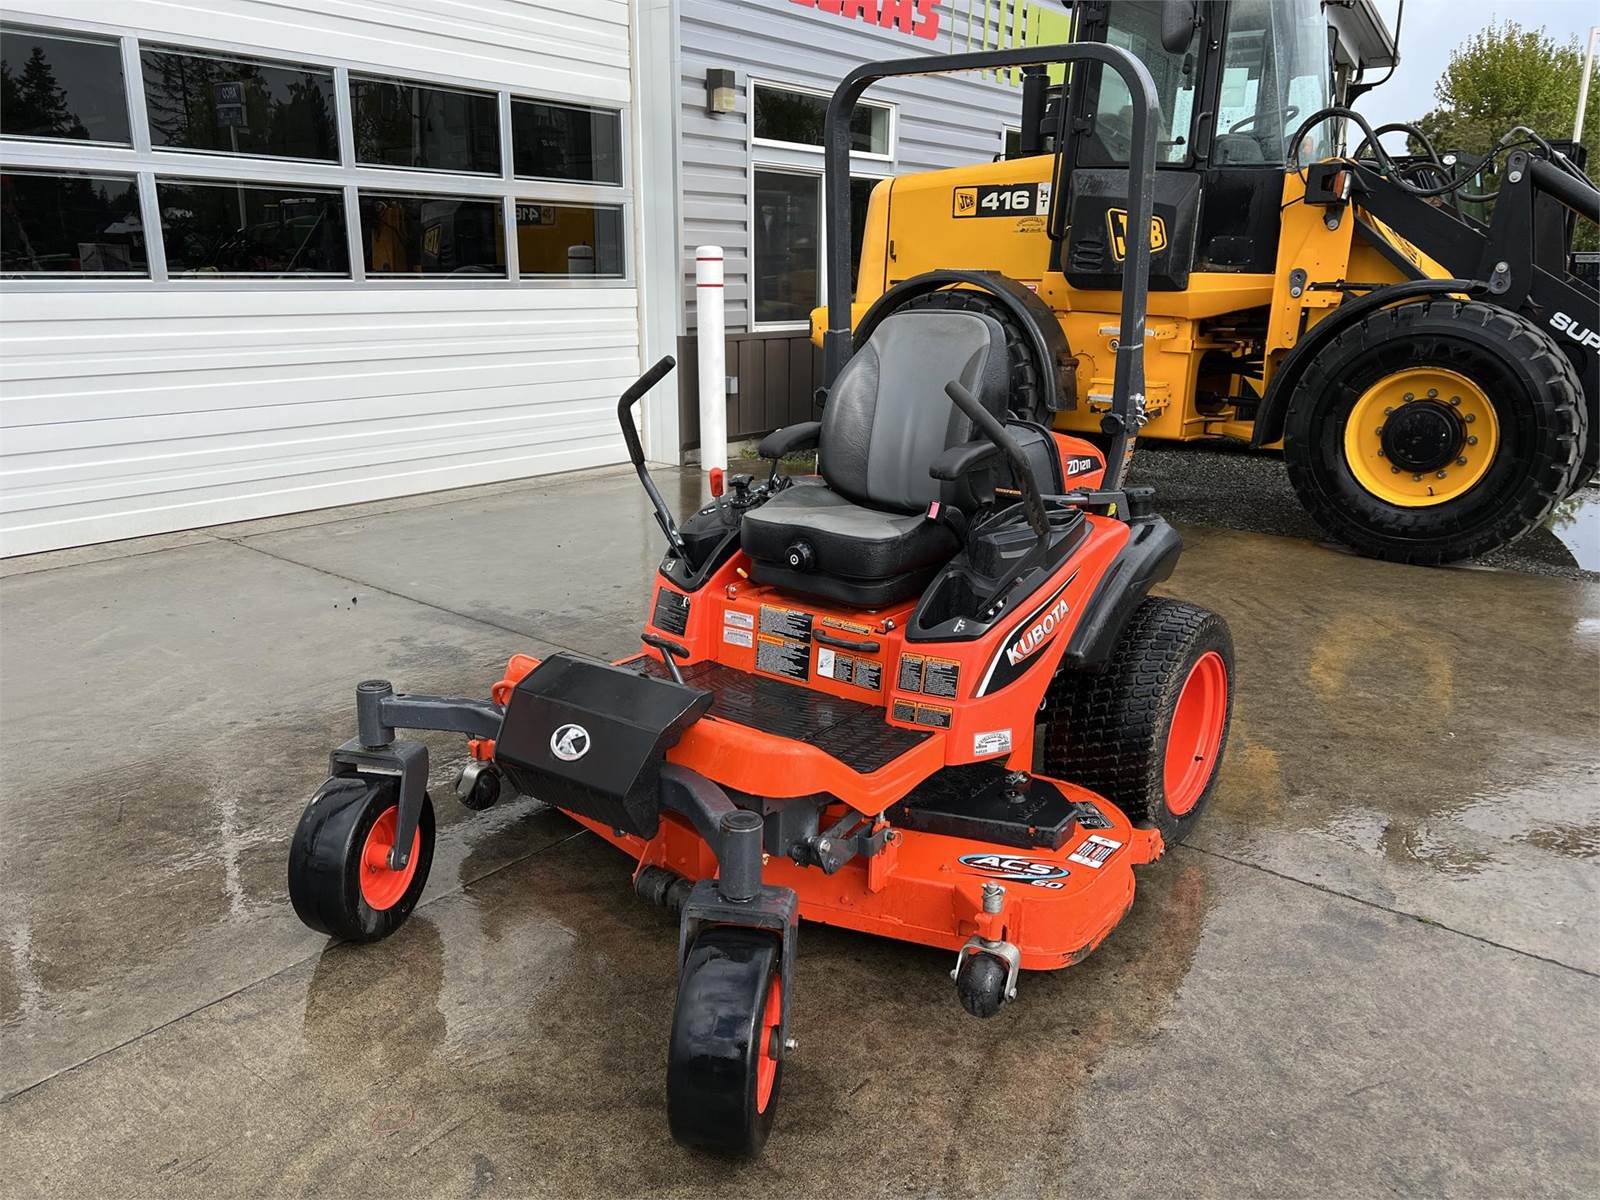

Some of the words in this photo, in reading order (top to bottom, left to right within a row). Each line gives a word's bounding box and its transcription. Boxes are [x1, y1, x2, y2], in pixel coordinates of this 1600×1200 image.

[959, 195, 975, 211] JCB
[981, 191, 1030, 210] 416
[1116, 214, 1163, 256] JB
[1549, 311, 1600, 356] SUP
[1006, 599, 1069, 666] KUBOTA
[973, 856, 1055, 875] ACS
[1031, 880, 1065, 889] 60
